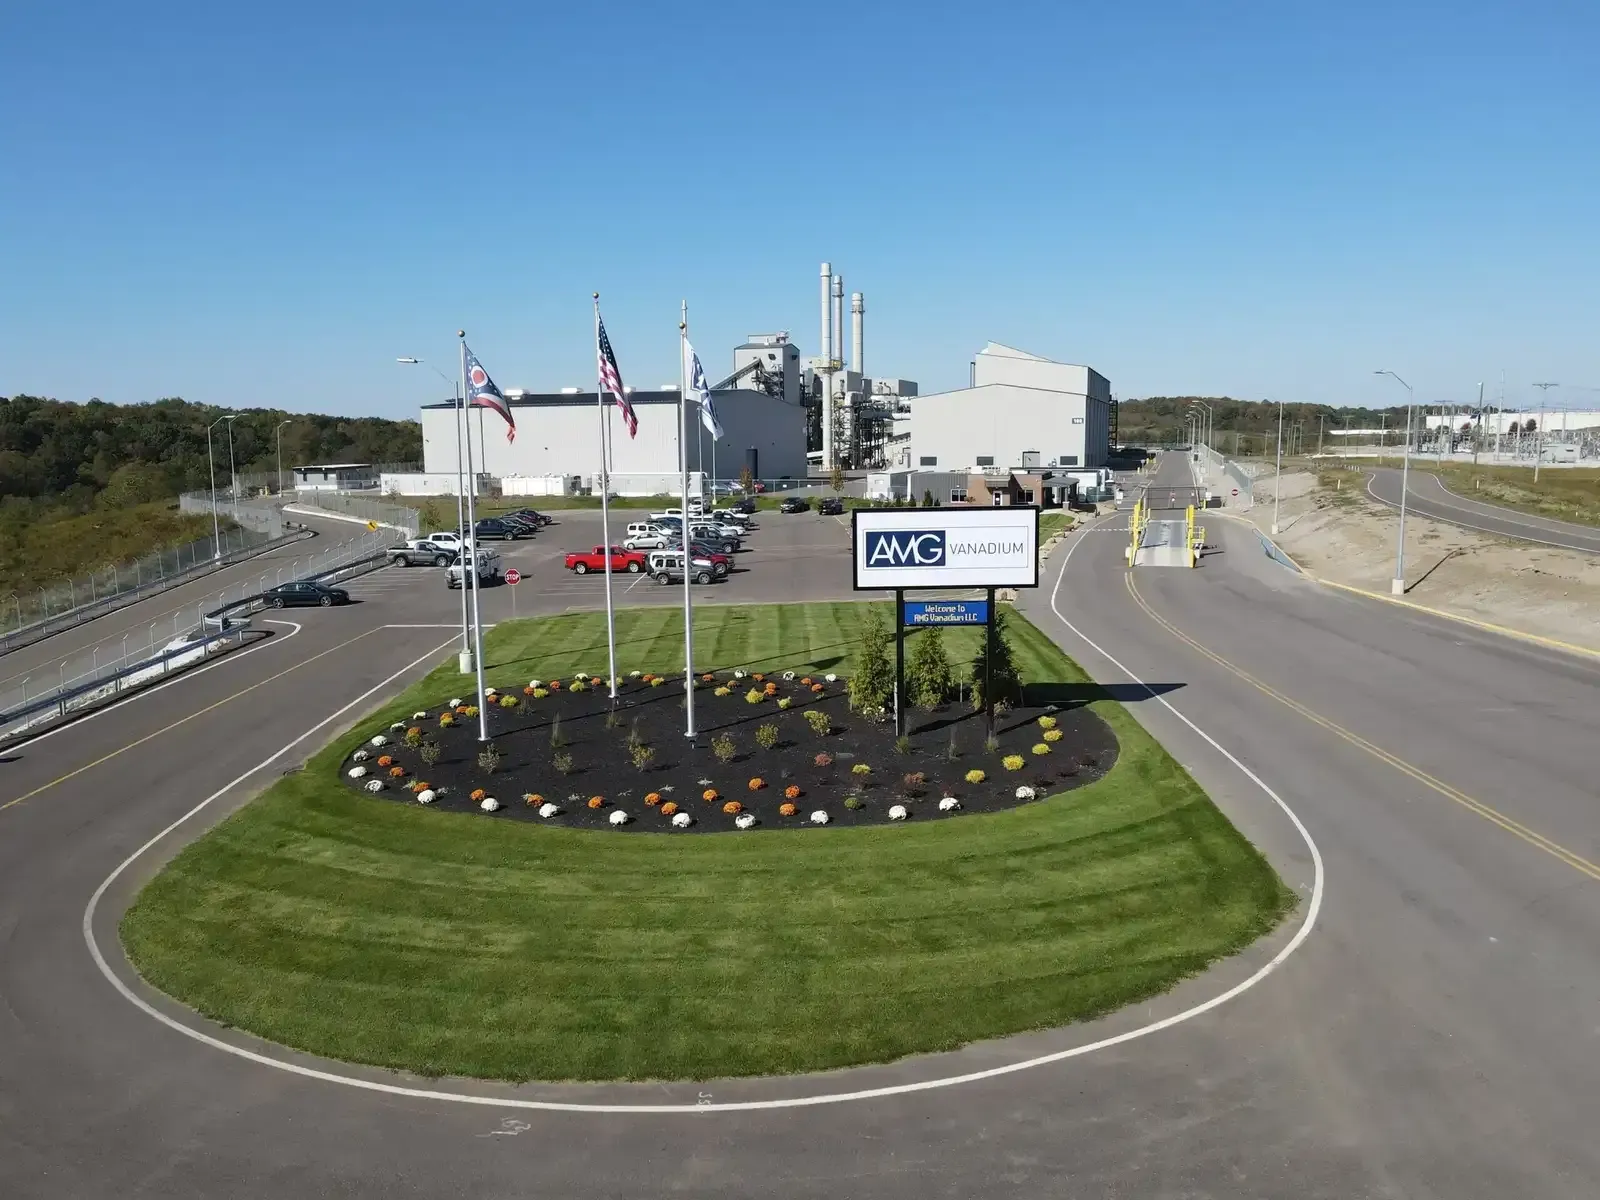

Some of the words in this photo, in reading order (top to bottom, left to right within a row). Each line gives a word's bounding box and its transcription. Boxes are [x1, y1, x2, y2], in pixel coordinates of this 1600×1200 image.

[869, 534, 943, 565] AMG
[949, 542, 1024, 555] VANADIUM
[914, 614, 929, 622] AMG
